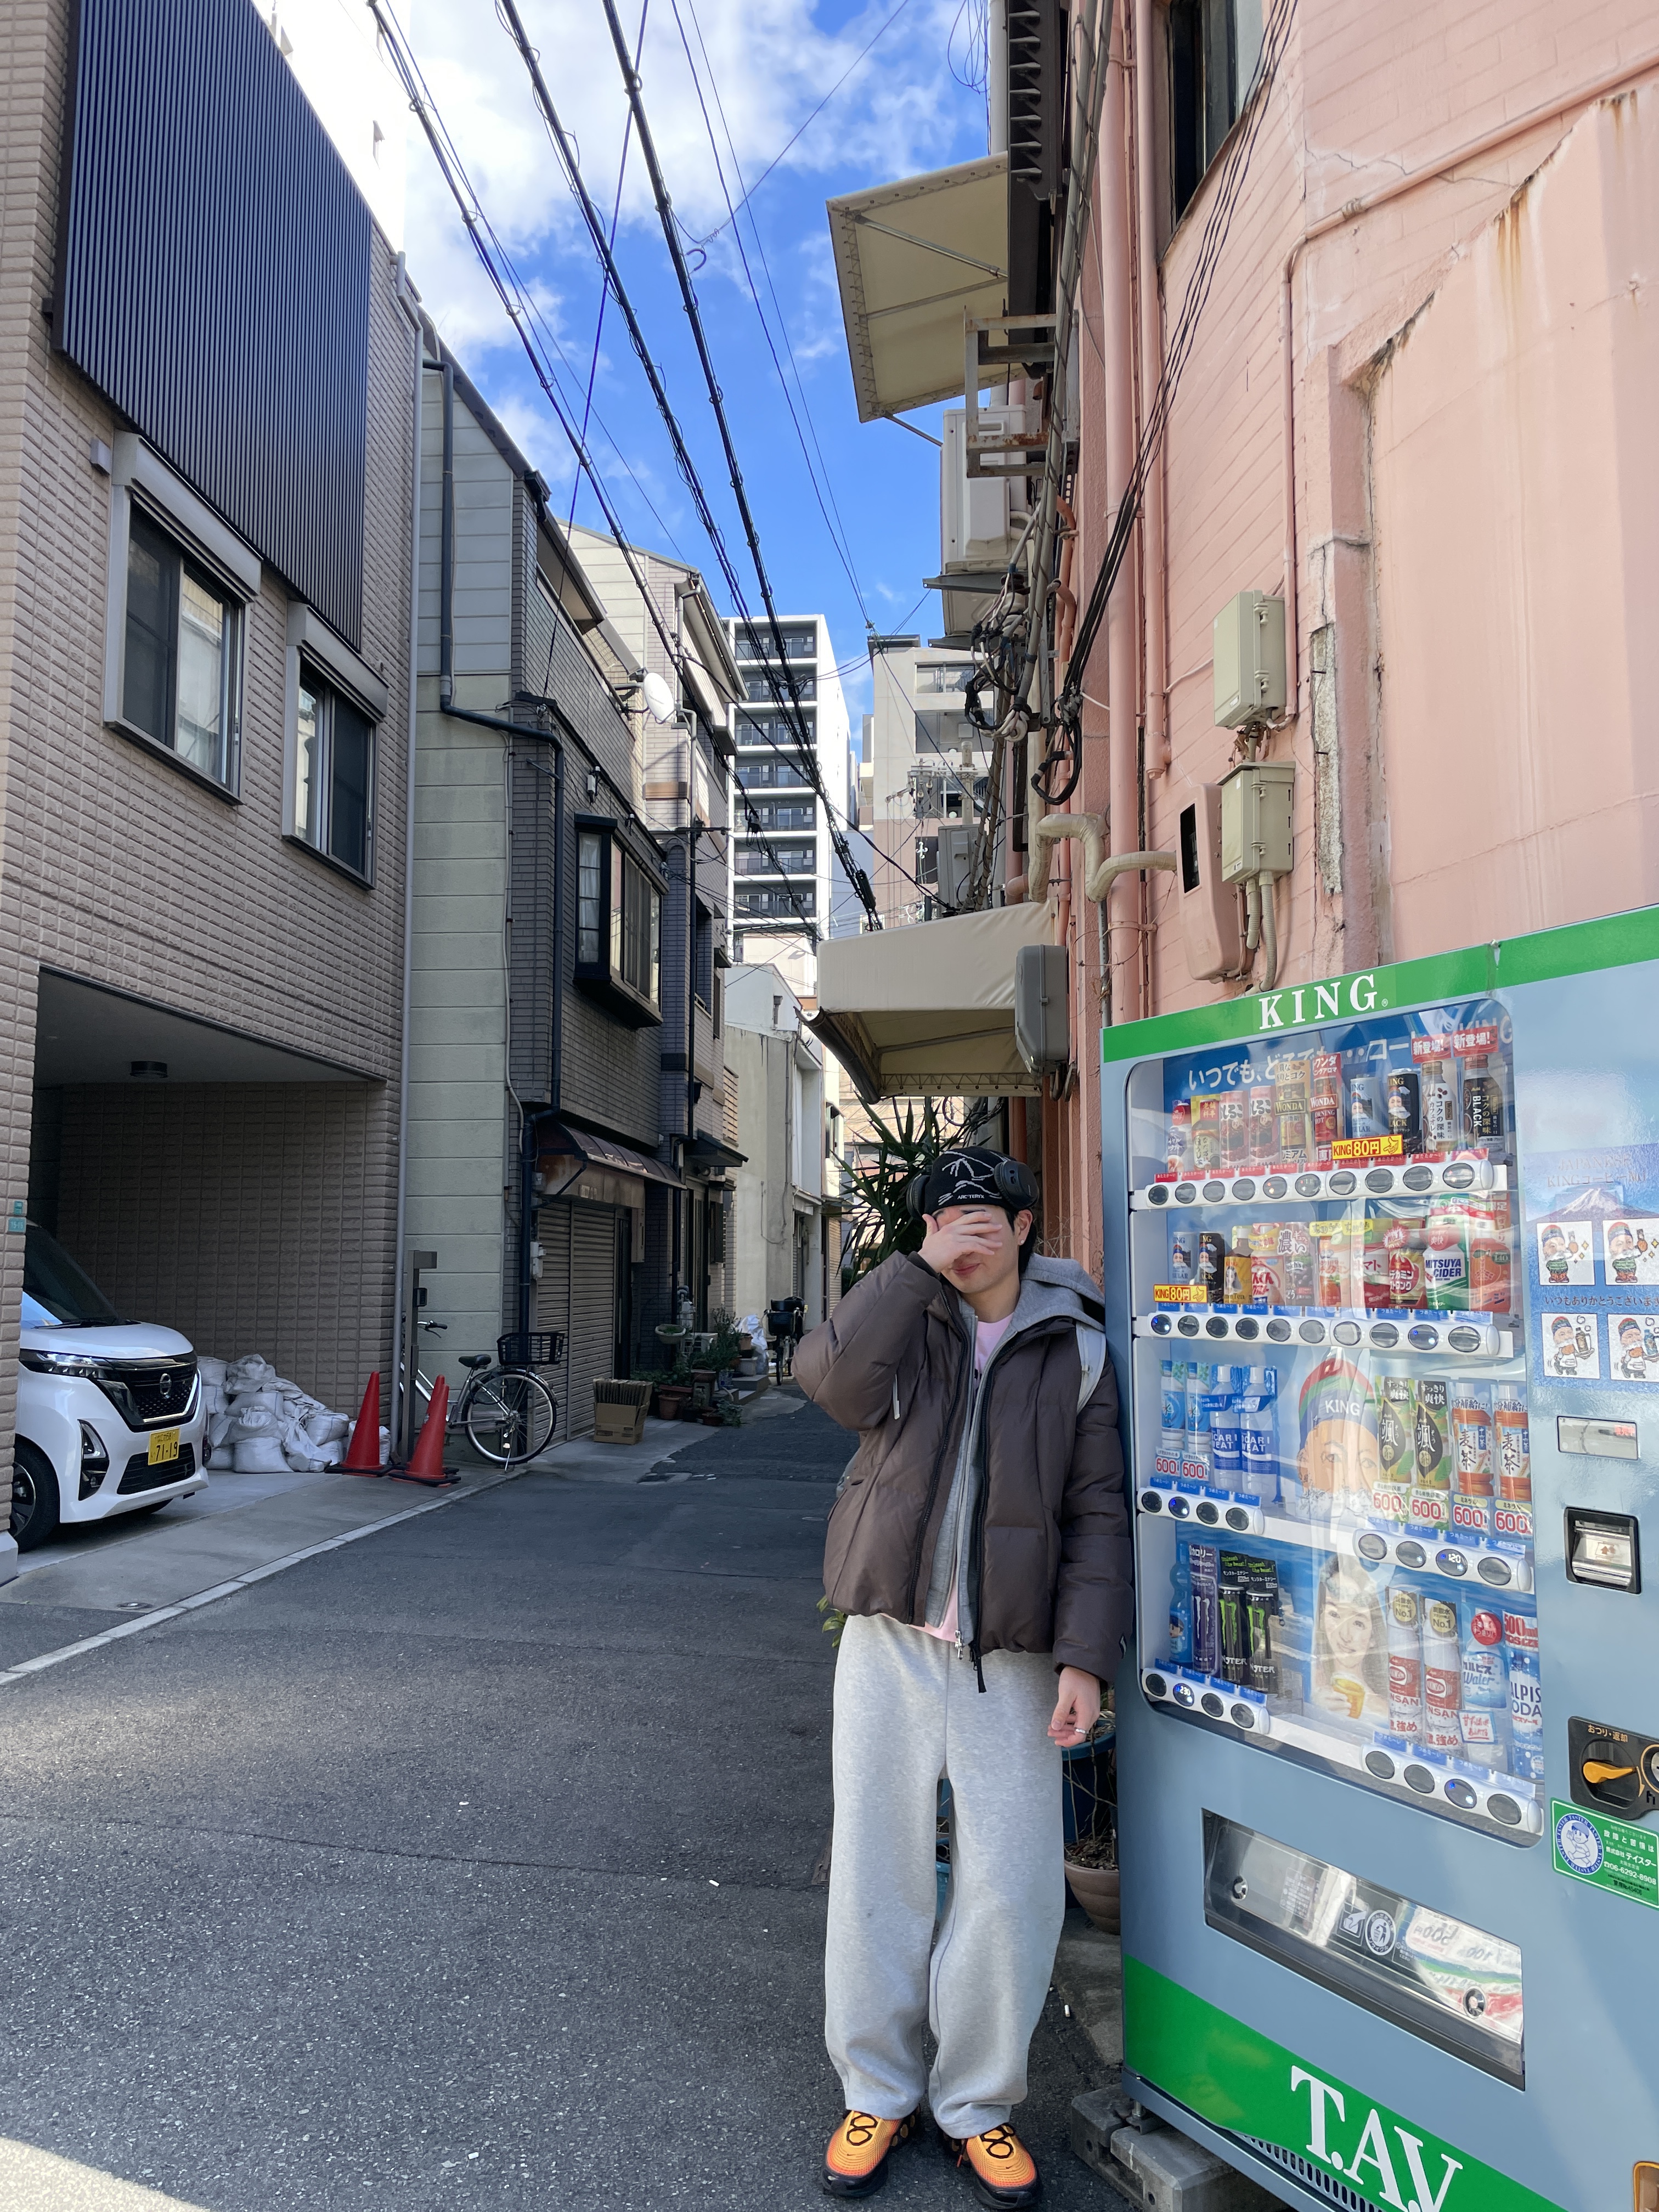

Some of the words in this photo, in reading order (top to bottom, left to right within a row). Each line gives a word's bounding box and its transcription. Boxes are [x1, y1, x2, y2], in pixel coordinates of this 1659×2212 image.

[1258, 974, 1378, 1030] KING
[1413, 1039, 1443, 1056] 新登場!
[1454, 1031, 1490, 1049] 新登場!
[1389, 1077, 1404, 1086] ING
[1276, 1102, 1303, 1113] WONDA
[1310, 1096, 1335, 1108] WONDA
[1472, 1095, 1482, 1127] BLACK
[1481, 1095, 1492, 1135] コクの深味
[1389, 1118, 1407, 1127] LACK
[1436, 1101, 1445, 1139] コクの深味
[1333, 1144, 1352, 1156] KING
[1352, 1139, 1380, 1156] 80円
[1425, 1259, 1462, 1268] MITSUYA
[1433, 1268, 1462, 1278] CIDER
[1155, 1288, 1169, 1299] KING
[1169, 1286, 1191, 1301] 80円
[1390, 1390, 1409, 1401] 爽快
[1421, 1384, 1444, 1394] すっきり
[1425, 1393, 1445, 1404] 爽快
[1325, 1399, 1361, 1417] KING
[1242, 1435, 1270, 1444] OCARI
[156, 1441, 178, 1462] 71-19
[1459, 1429, 1476, 1471] 麦茶
[1502, 1431, 1520, 1475] 麦茶
[1432, 1618, 1452, 1629] No.1
[1390, 1692, 1420, 1707] NSAN
[1510, 1681, 1541, 1703] ALPIS
[1427, 1706, 1458, 1719] NSAN
[1512, 1702, 1542, 1718] ODA
[1588, 1724, 1628, 1743] おつり・返却
[1626, 1852, 1657, 1867] テイスター
